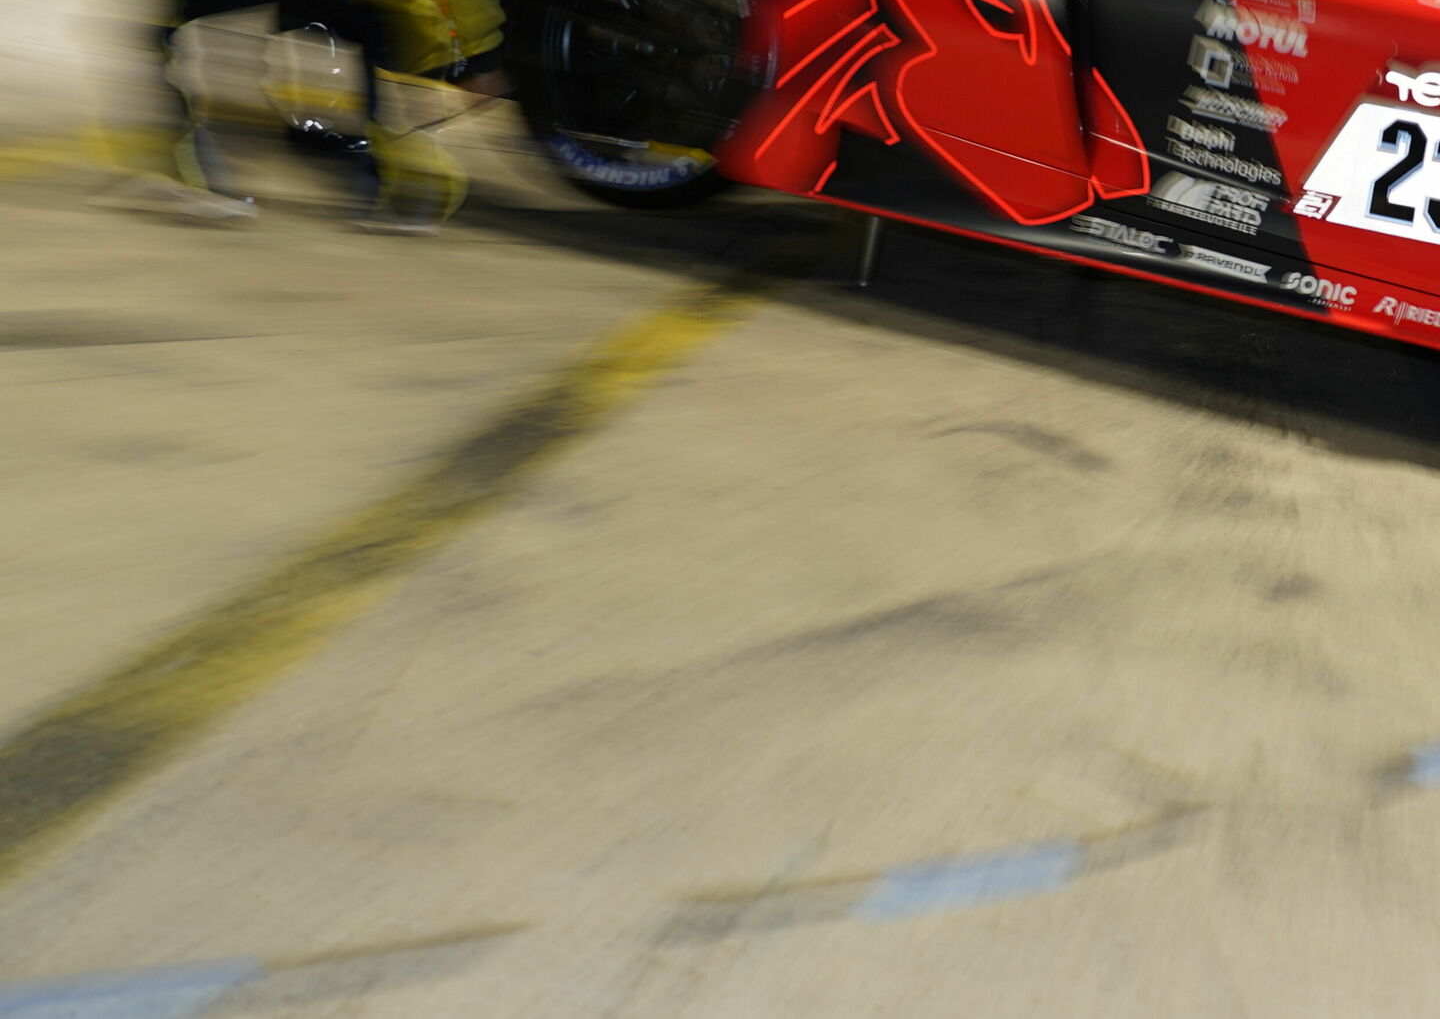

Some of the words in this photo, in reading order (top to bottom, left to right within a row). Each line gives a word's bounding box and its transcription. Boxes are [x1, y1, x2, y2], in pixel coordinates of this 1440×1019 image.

[1203, 13, 1309, 58] MOTUL
[1177, 124, 1236, 153] Delphi
[1178, 142, 1283, 186] Technologies
